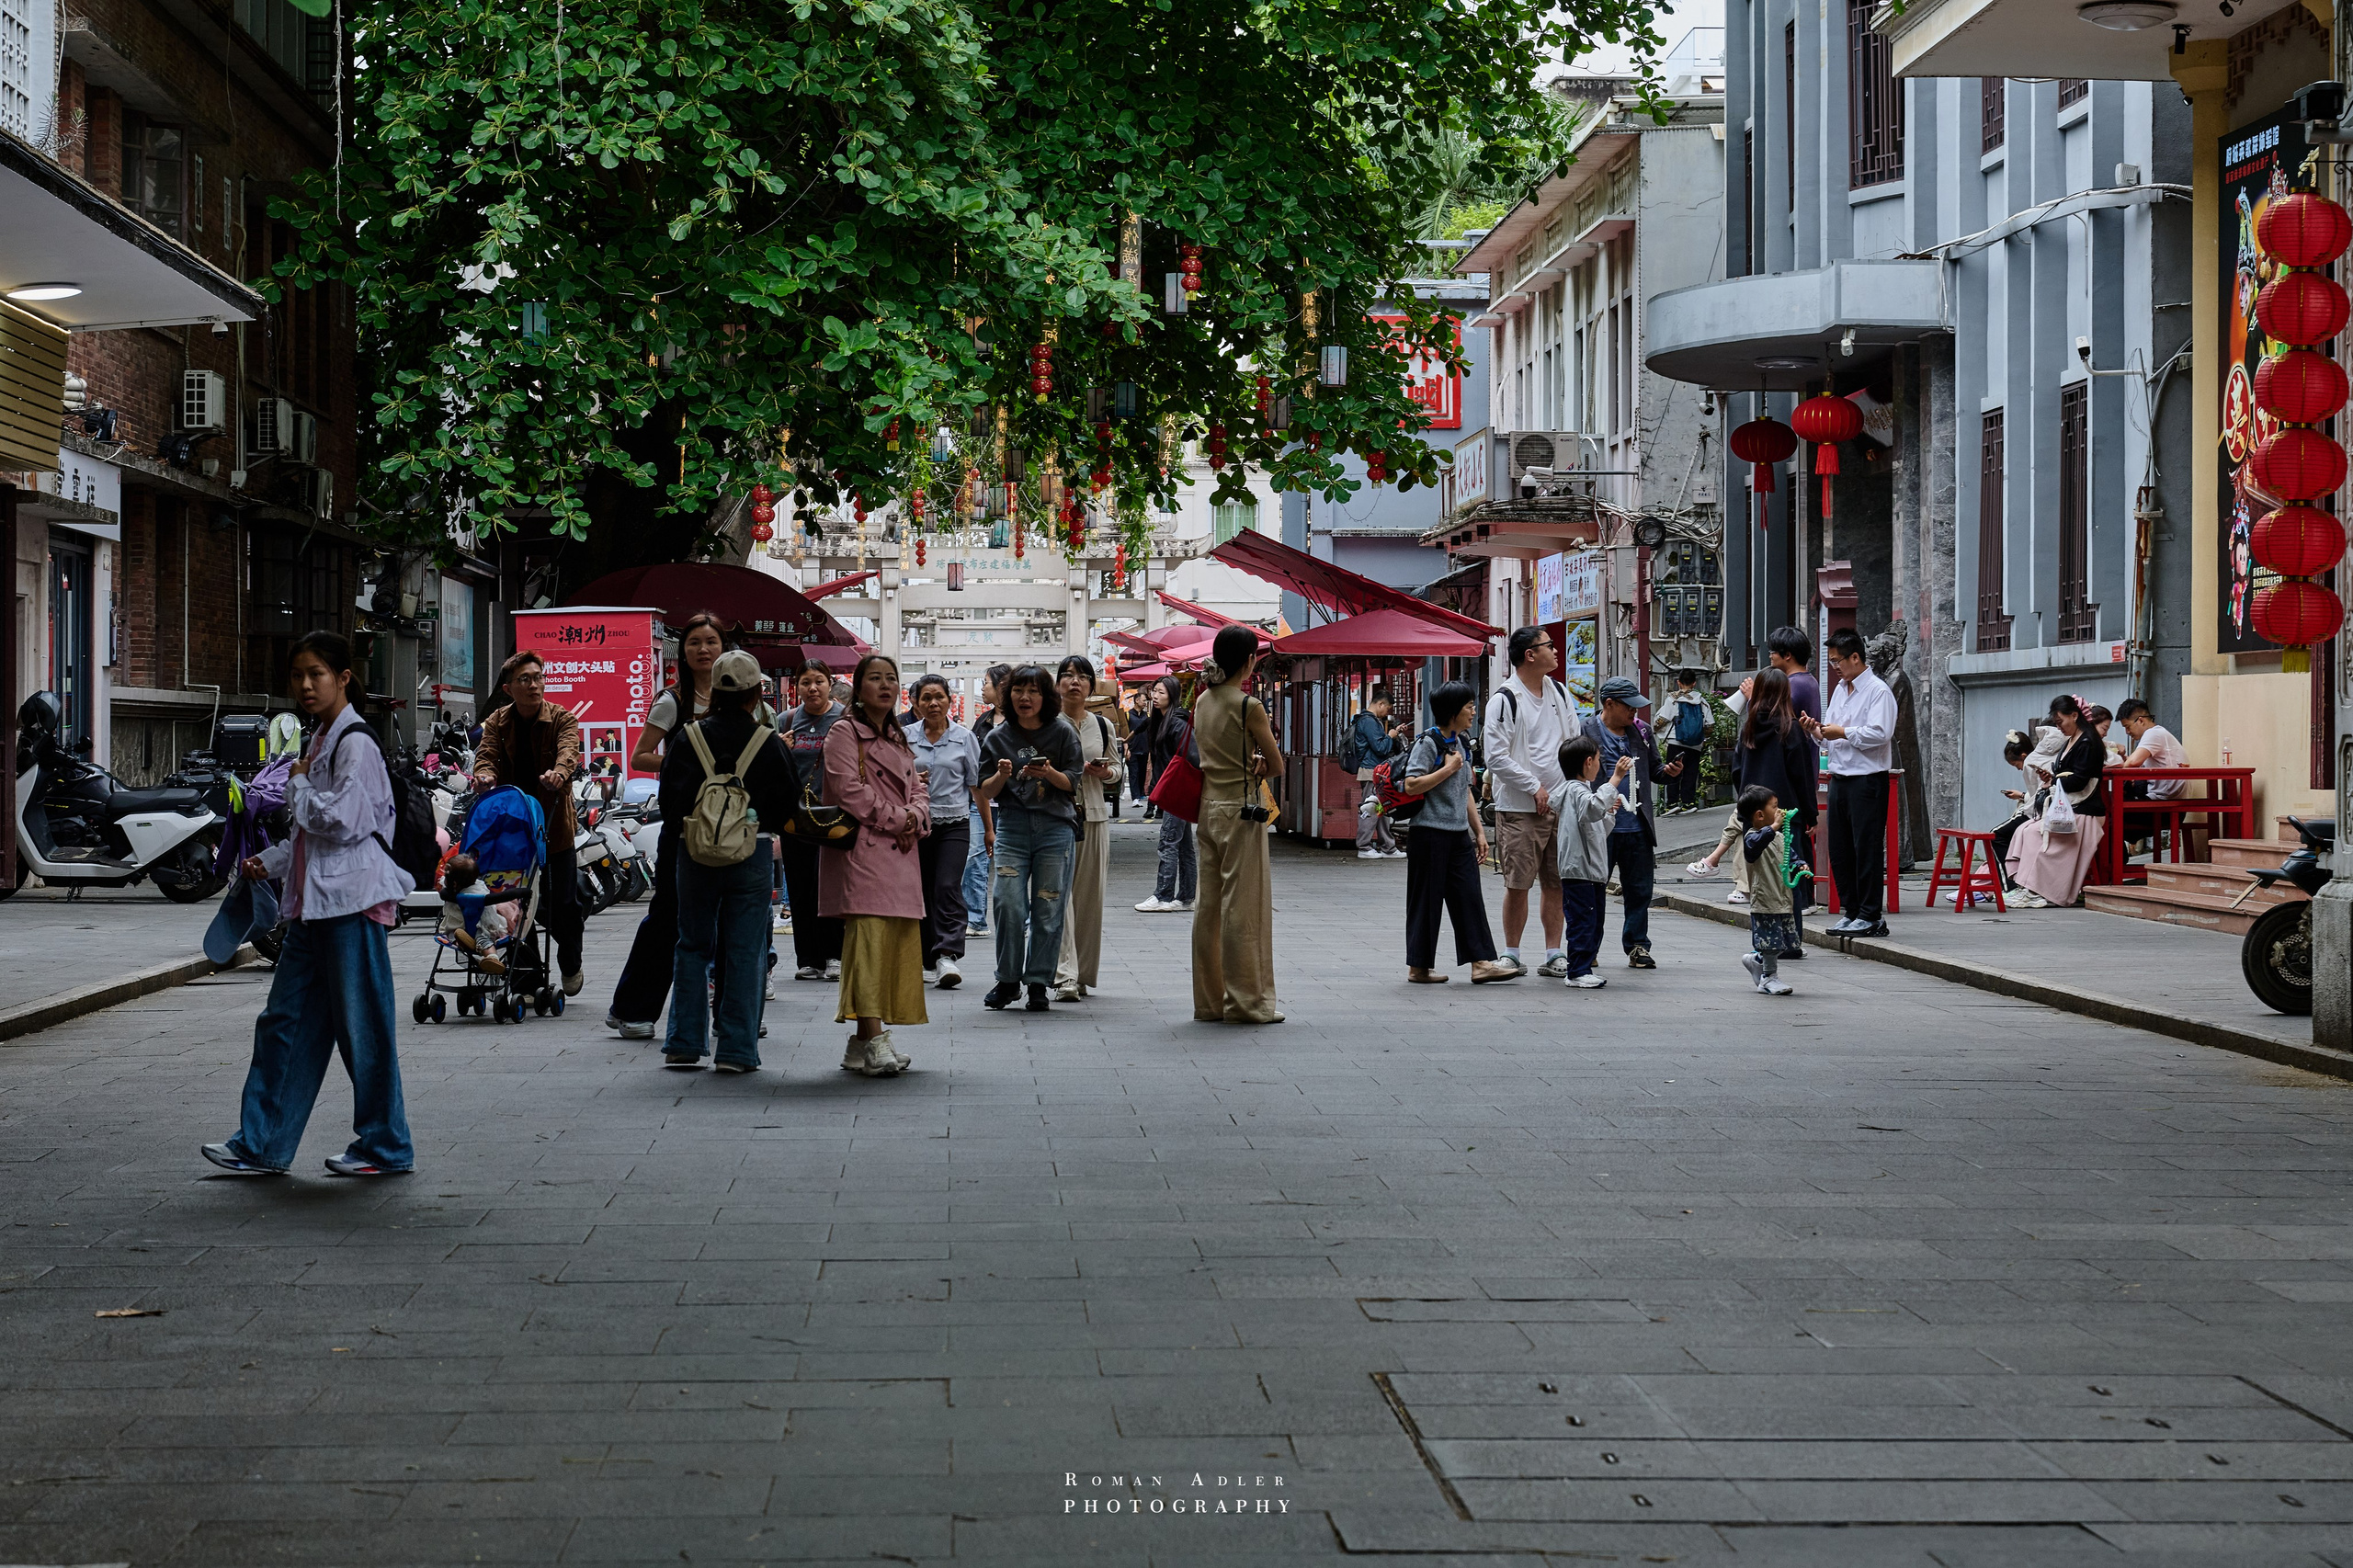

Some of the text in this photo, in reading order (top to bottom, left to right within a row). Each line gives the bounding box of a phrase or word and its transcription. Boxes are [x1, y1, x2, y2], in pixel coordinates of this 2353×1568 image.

[558, 625, 606, 645] 潮州
[542, 661, 616, 675] 州文创大头贴
[626, 654, 644, 727] Photo.
